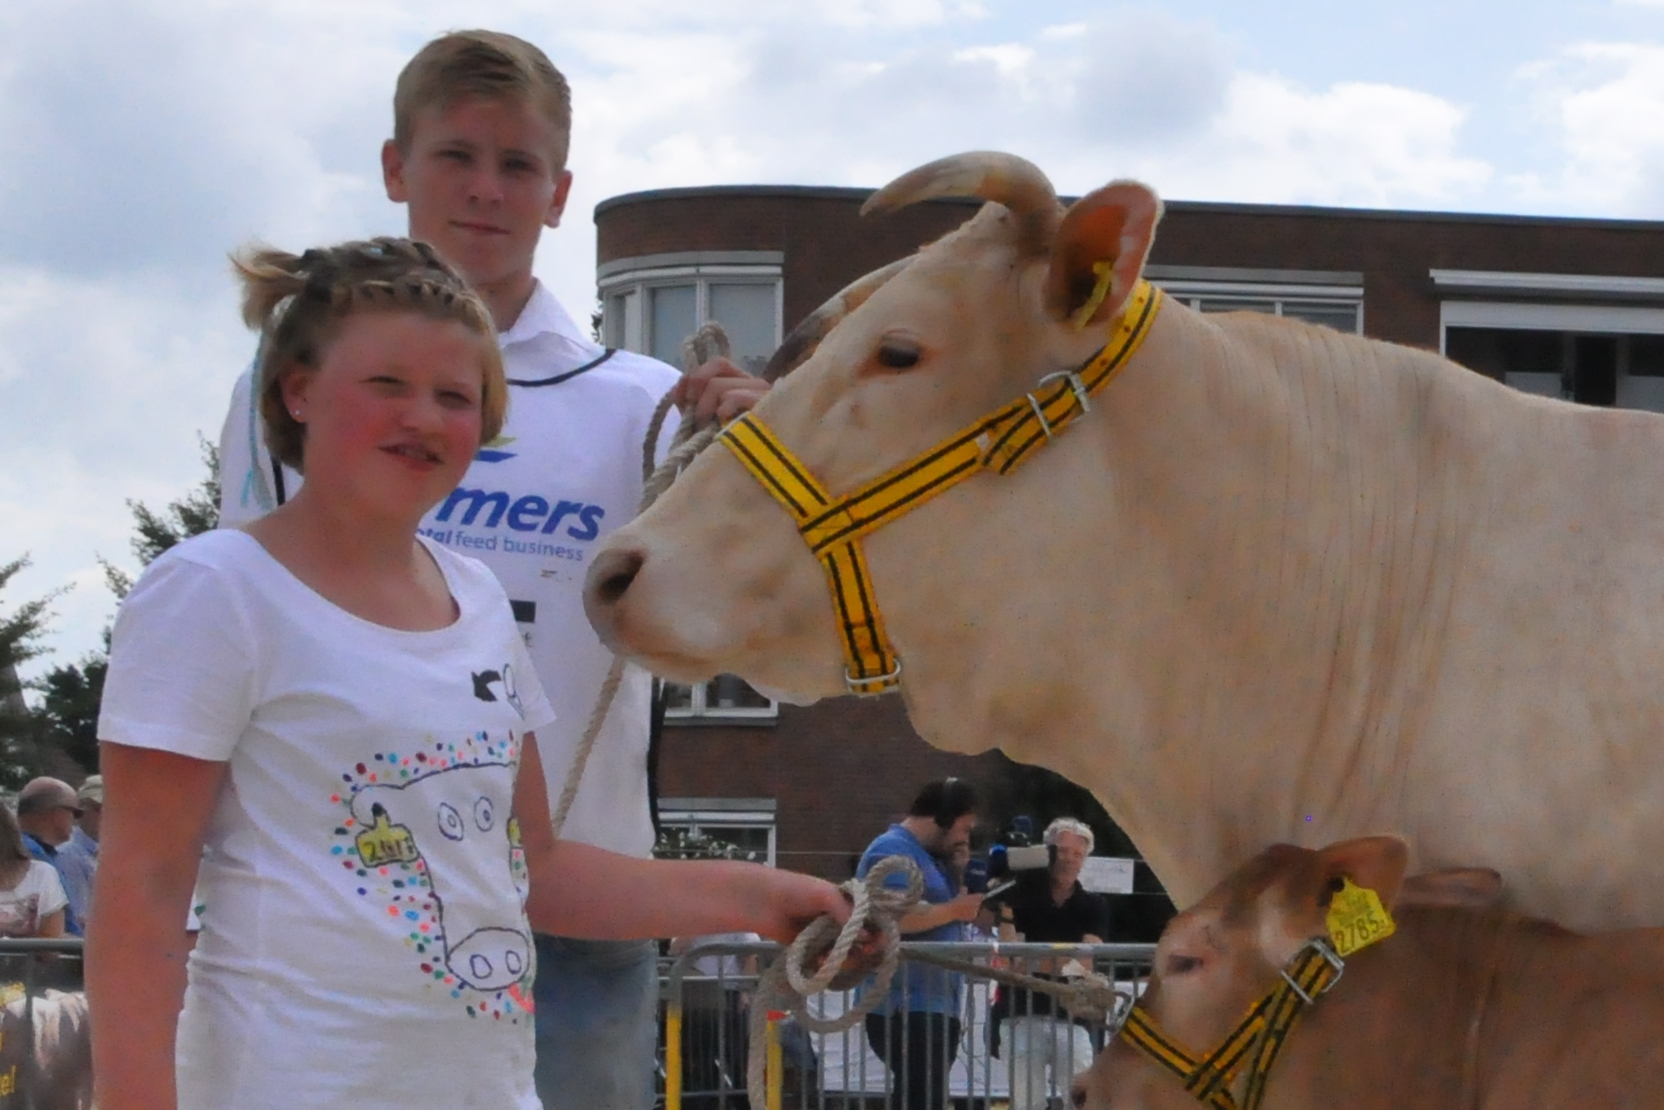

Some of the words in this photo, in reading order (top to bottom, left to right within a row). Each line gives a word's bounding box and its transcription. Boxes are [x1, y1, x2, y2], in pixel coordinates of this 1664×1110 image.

[435, 486, 605, 542] mers
[456, 531, 497, 551] feed
[503, 536, 584, 562] business
[1334, 910, 1380, 954] 2785
